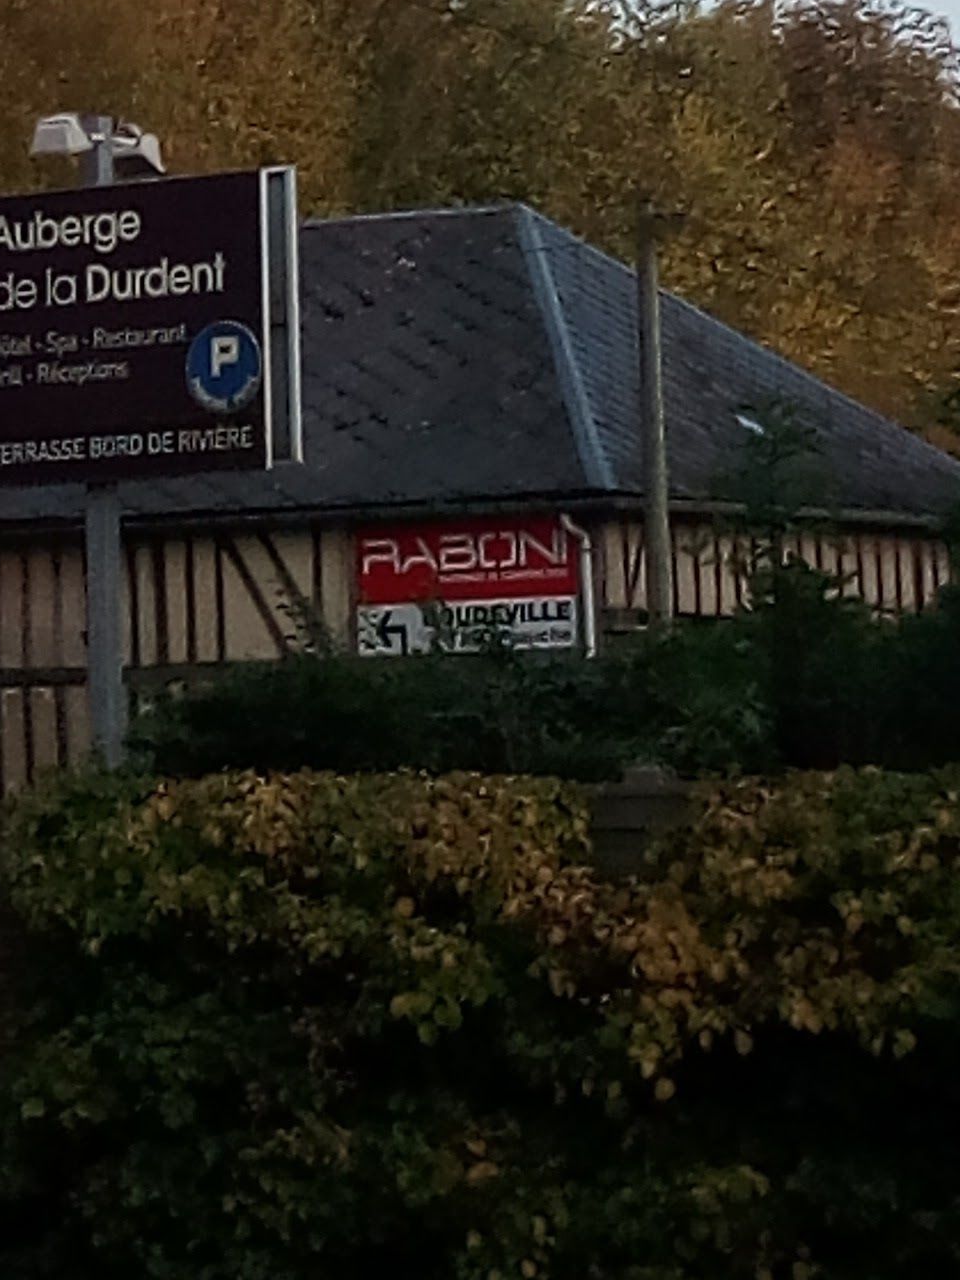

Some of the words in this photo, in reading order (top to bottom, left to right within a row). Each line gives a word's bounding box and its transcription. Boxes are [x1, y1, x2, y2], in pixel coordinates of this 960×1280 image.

[45, 268, 77, 306] la
[85, 252, 226, 301] Durdent
[44, 330, 78, 356] Spa
[93, 323, 187, 349] Restaurant
[210, 336, 240, 378] P
[89, 433, 143, 458] BORD
[147, 431, 175, 454] DE
[361, 530, 568, 576] RABONI
